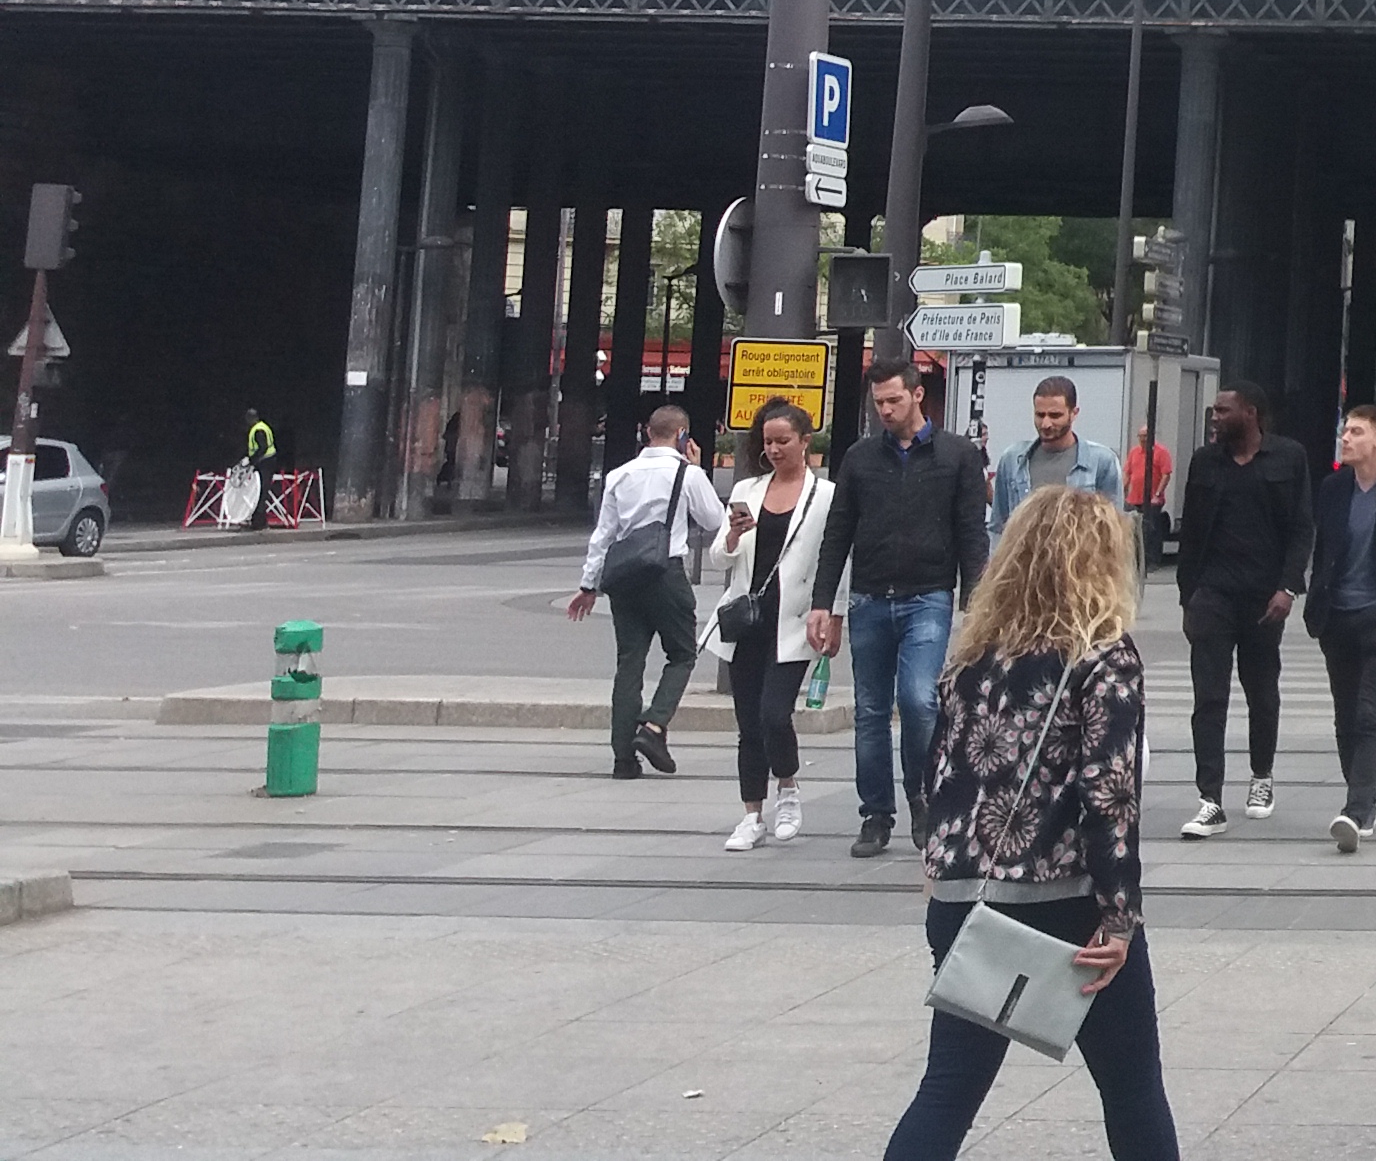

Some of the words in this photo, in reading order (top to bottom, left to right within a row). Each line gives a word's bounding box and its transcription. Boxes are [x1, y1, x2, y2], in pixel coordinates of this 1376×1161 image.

[822, 74, 841, 127] P
[945, 273, 969, 285] Place
[973, 272, 1003, 285] Balard
[922, 313, 964, 326] Préfecture
[967, 313, 977, 325] de
[980, 312, 1001, 325] Paris
[920, 330, 930, 341] et
[953, 329, 962, 341] de
[966, 329, 994, 341] France
[741, 350, 771, 364] Rouge
[773, 351, 820, 364] clignotant
[742, 367, 764, 377] arrêt
[767, 367, 816, 380] obligatoire
